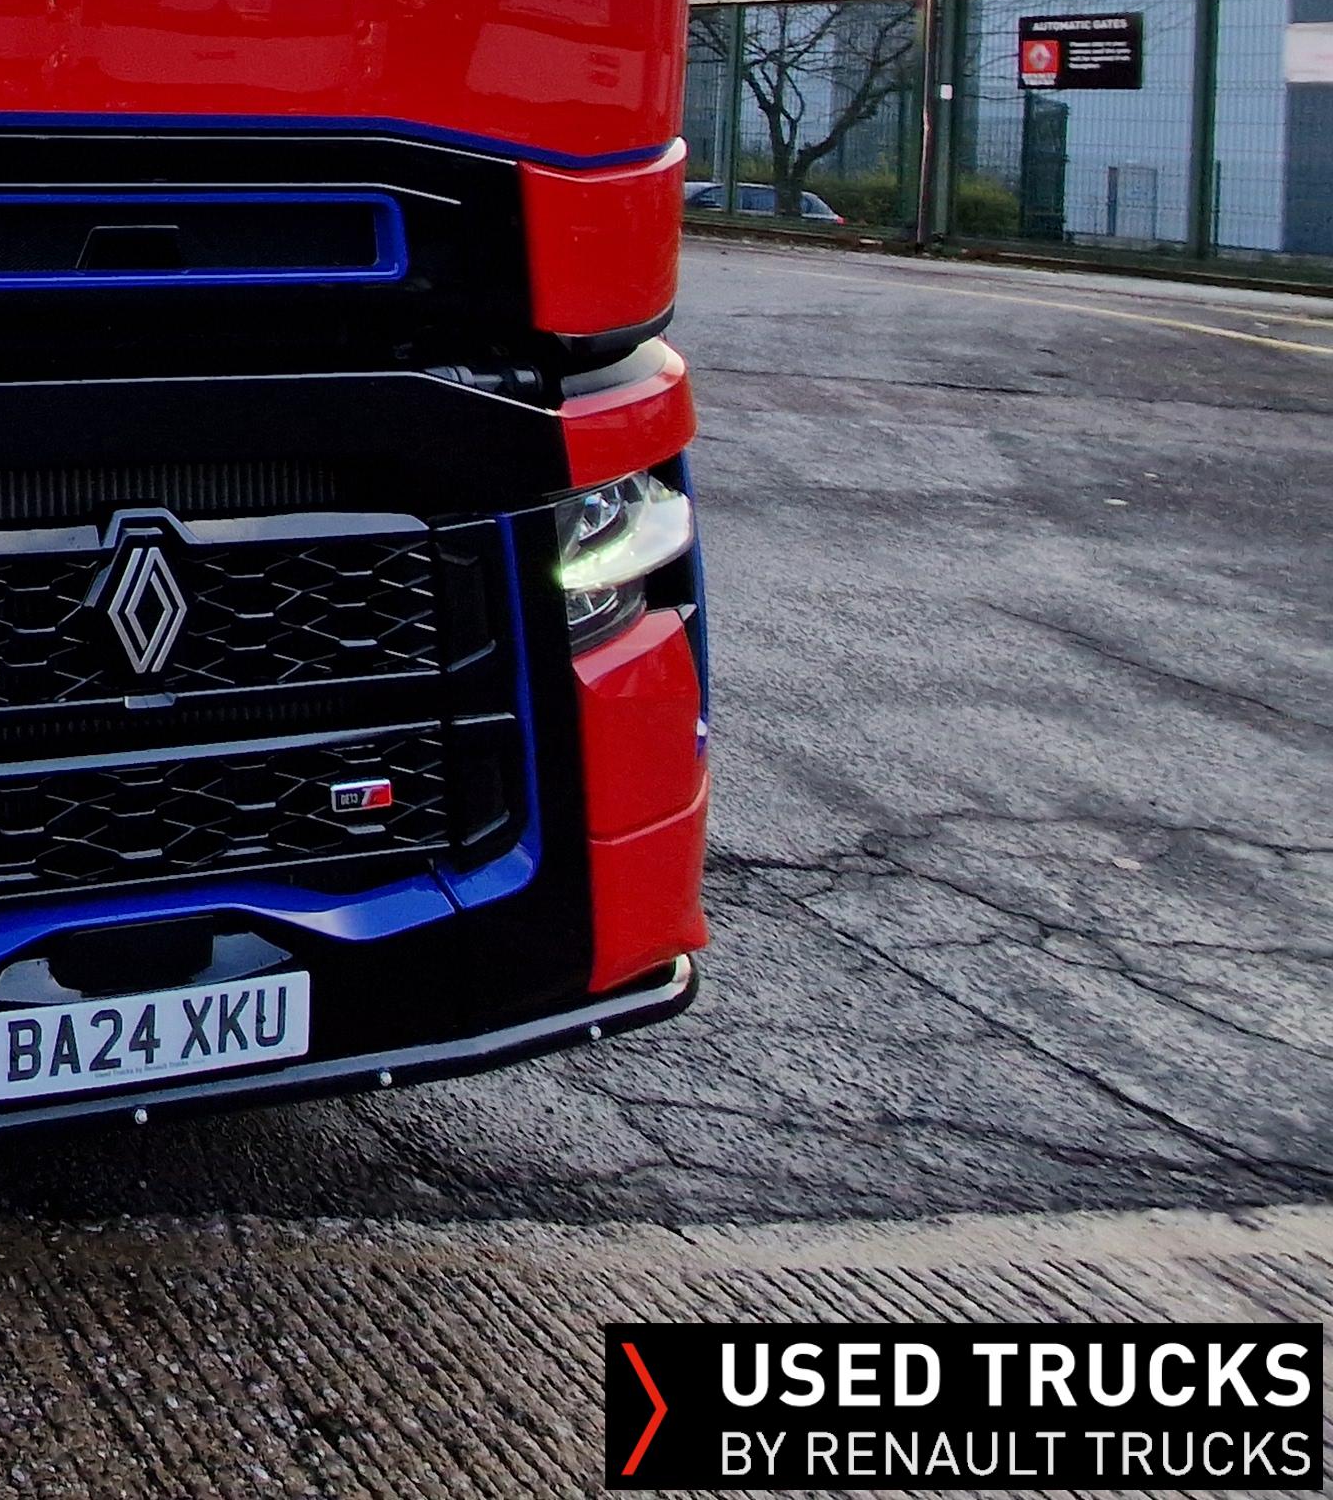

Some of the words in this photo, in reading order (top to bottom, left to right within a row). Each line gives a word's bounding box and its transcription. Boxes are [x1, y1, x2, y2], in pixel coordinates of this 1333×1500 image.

[1033, 20, 1092, 31] AUTOMATIC
[1093, 18, 1128, 29] GATES
[7, 1003, 161, 1083] BA24
[180, 986, 287, 1060] XKU
